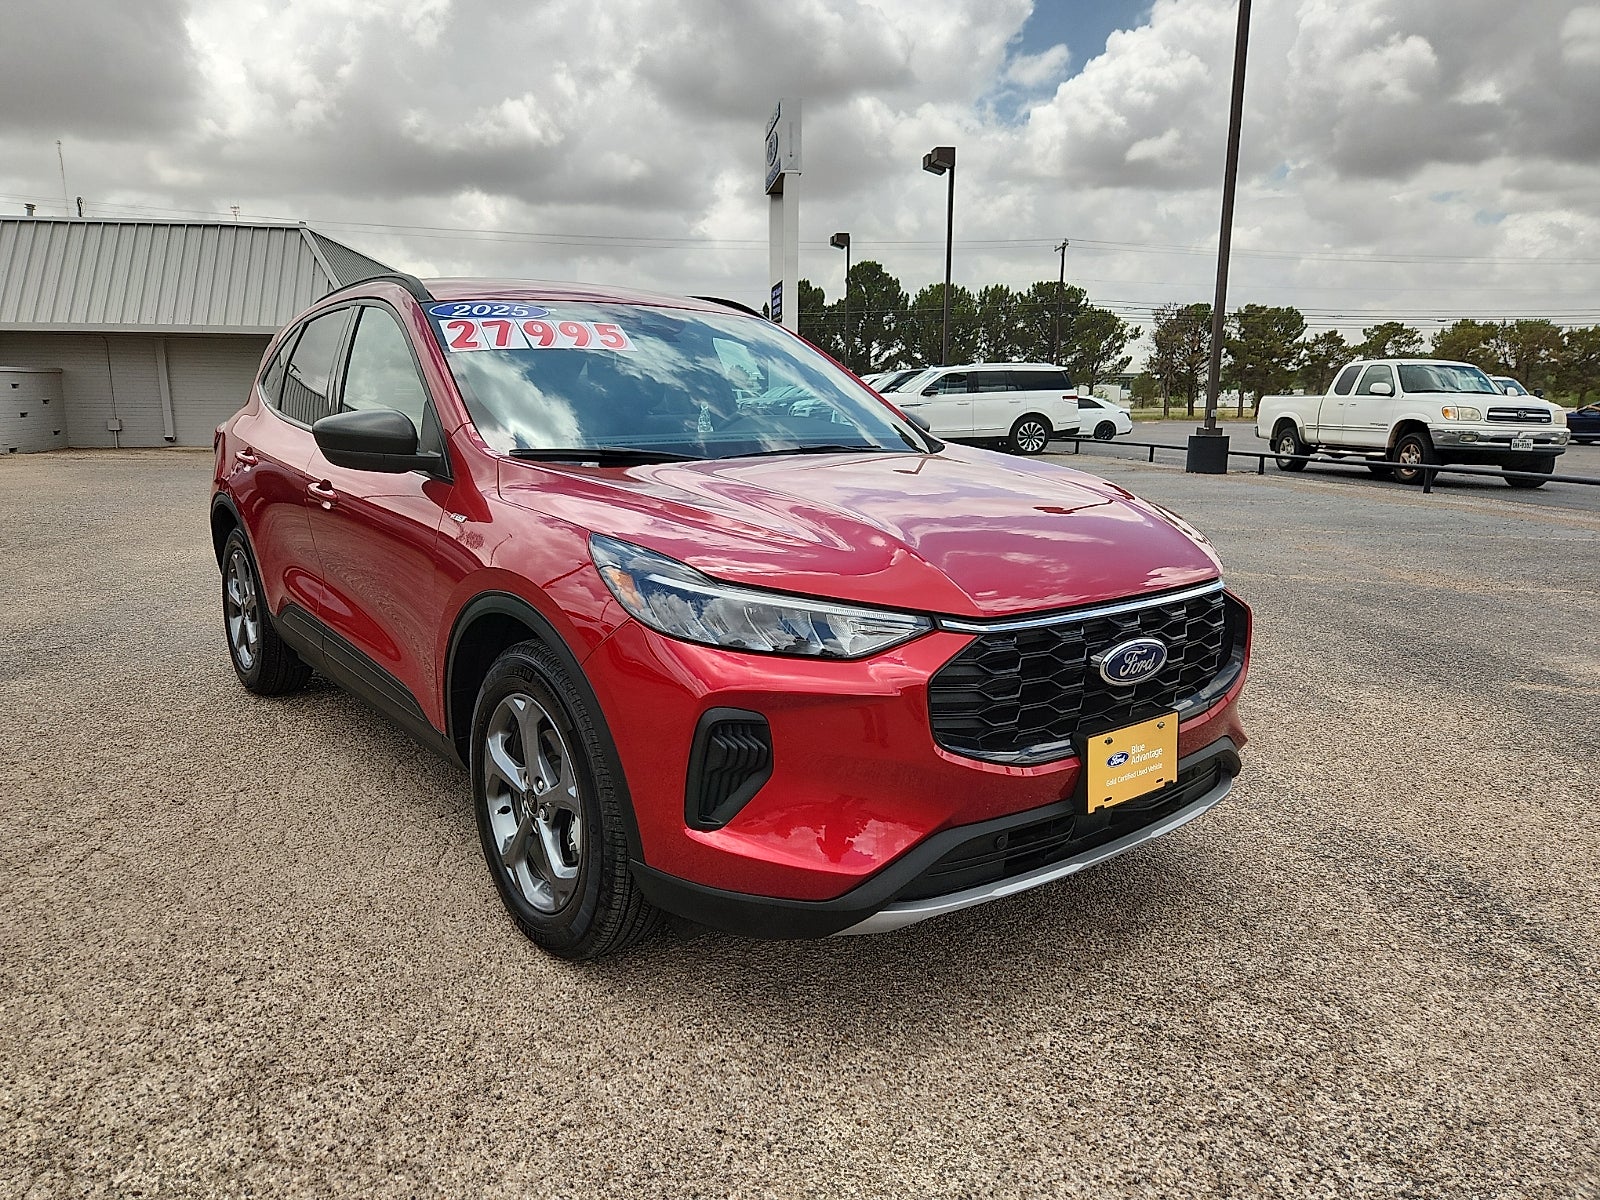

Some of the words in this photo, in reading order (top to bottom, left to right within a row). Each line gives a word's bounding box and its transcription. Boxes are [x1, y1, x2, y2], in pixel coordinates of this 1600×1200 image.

[453, 304, 530, 317] 2025
[446, 320, 628, 349] 27995
[1120, 649, 1156, 676] Ford
[1131, 743, 1146, 755] Blue
[1131, 747, 1163, 765] Advantage
[1110, 753, 1126, 766] Ford
[1106, 778, 1117, 787] Gold
[1117, 771, 1137, 783] Certified
[1136, 768, 1148, 777] Used
[1147, 762, 1163, 773] Vehicle
